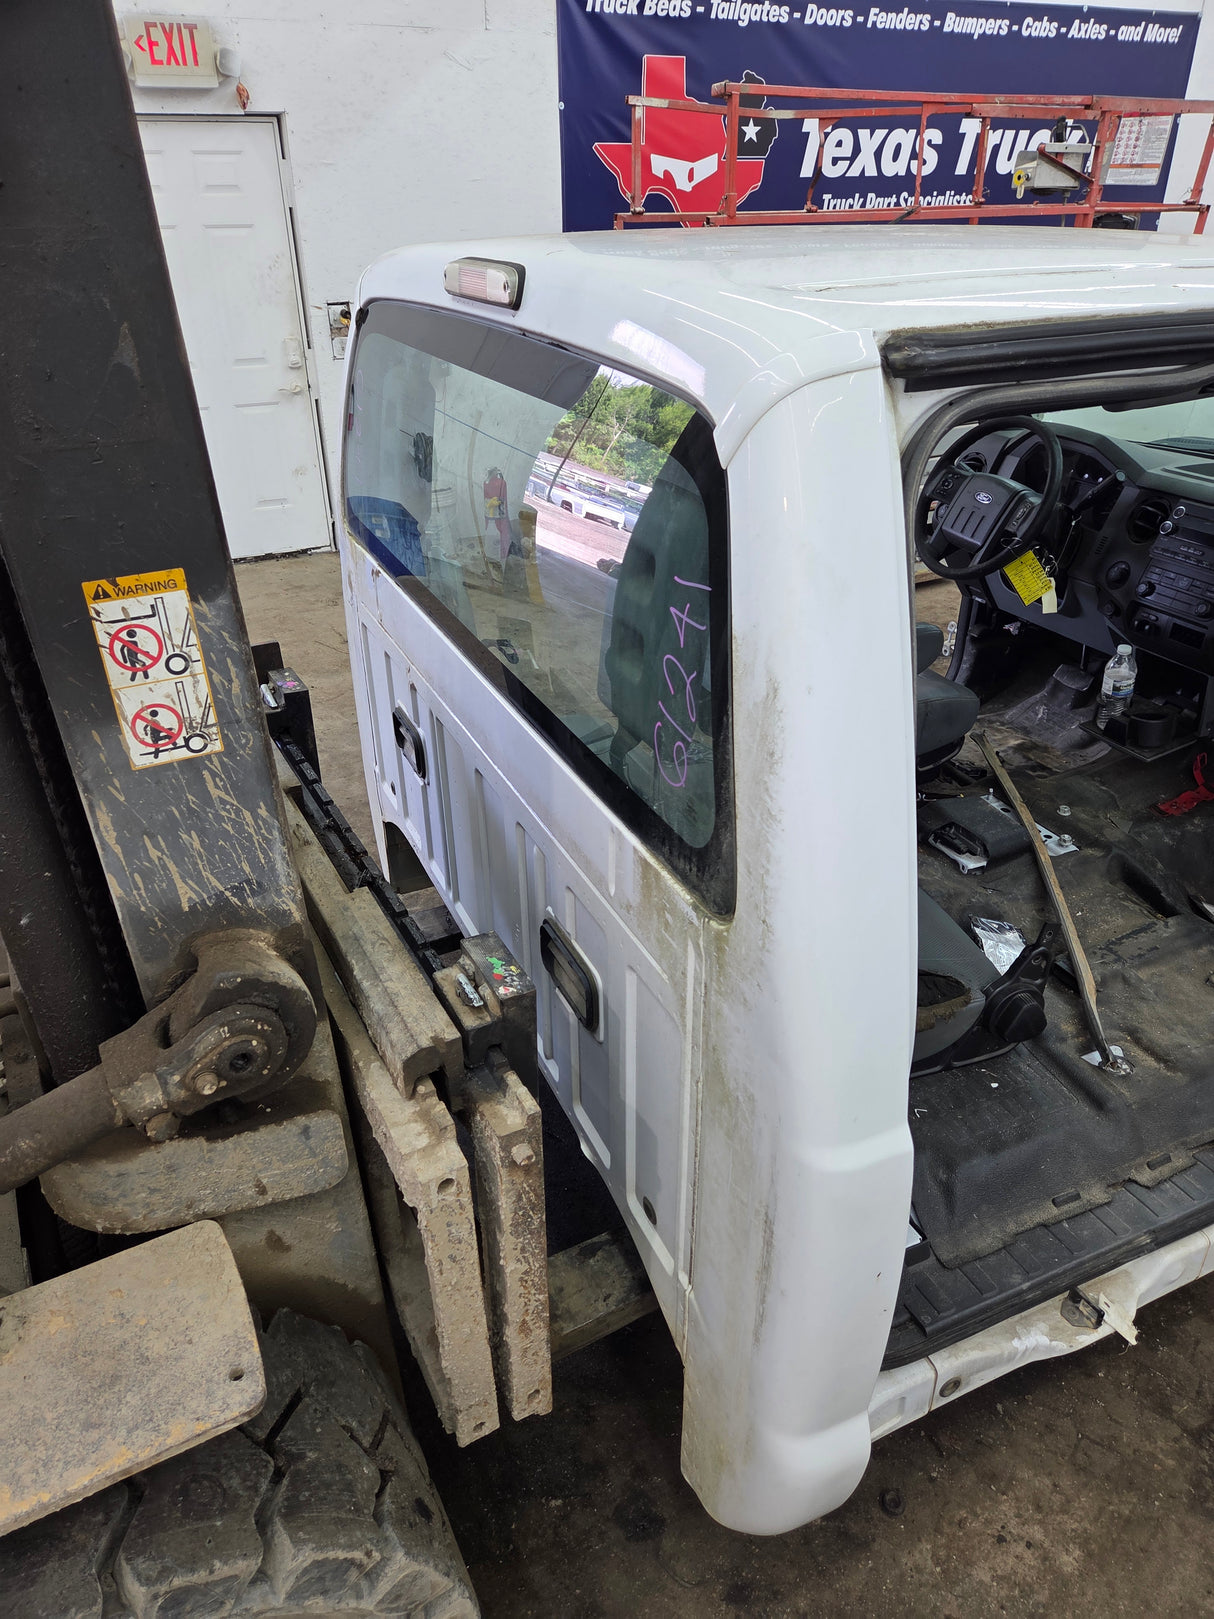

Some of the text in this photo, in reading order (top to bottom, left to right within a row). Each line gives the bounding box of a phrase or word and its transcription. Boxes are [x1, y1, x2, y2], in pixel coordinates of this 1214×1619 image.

[144, 21, 199, 67] EXIT
[643, 0, 692, 17] Beds
[710, 0, 790, 27] Tailgates
[804, 4, 854, 27] Doors
[867, 7, 931, 31] Fenders
[943, 12, 1010, 40] Bumpers
[1021, 16, 1058, 38] Cabs
[1068, 18, 1107, 40] Axles
[1117, 21, 1146, 42] and
[1143, 23, 1183, 44] More!
[799, 118, 943, 178] Texas
[822, 193, 864, 211] Truck
[865, 192, 897, 209] Part
[112, 578, 178, 598] WARNING
